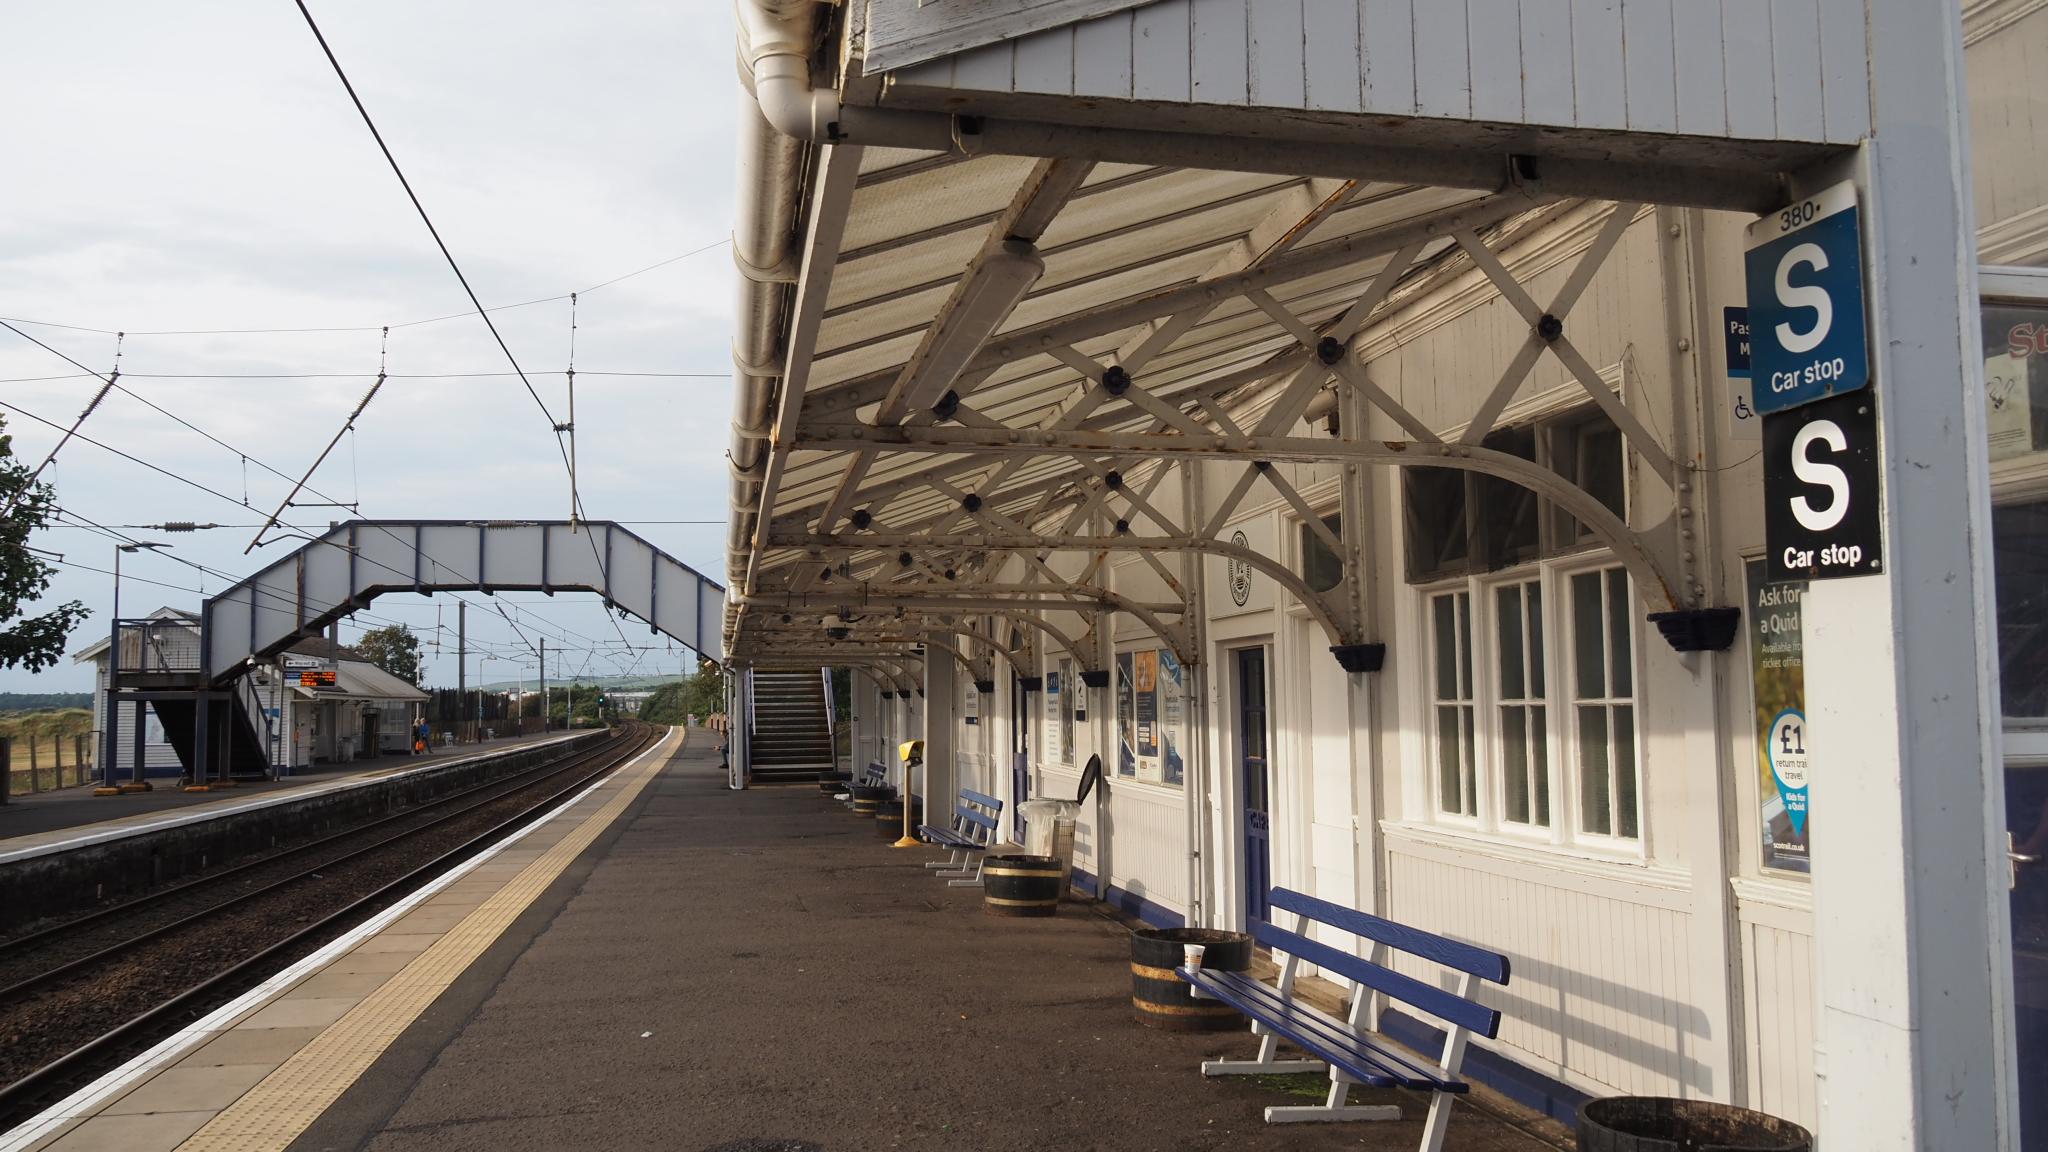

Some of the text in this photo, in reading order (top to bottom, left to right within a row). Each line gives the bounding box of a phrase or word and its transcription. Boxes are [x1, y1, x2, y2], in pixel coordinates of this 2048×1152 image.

[1774, 242, 1833, 353] S
[2007, 322, 2048, 360] St
[1771, 357, 1845, 393] Car stop
[1790, 419, 1850, 532] S
[1783, 543, 1862, 569] Car stop
[1759, 585, 1800, 607] Ask for
[1760, 611, 1799, 635] a Quid
[1761, 640, 1802, 654] Available fro
[1762, 656, 1801, 669] ticket office
[1780, 724, 1805, 755] £1
[1775, 758, 1808, 769] return trai
[1784, 770, 1804, 781] travel
